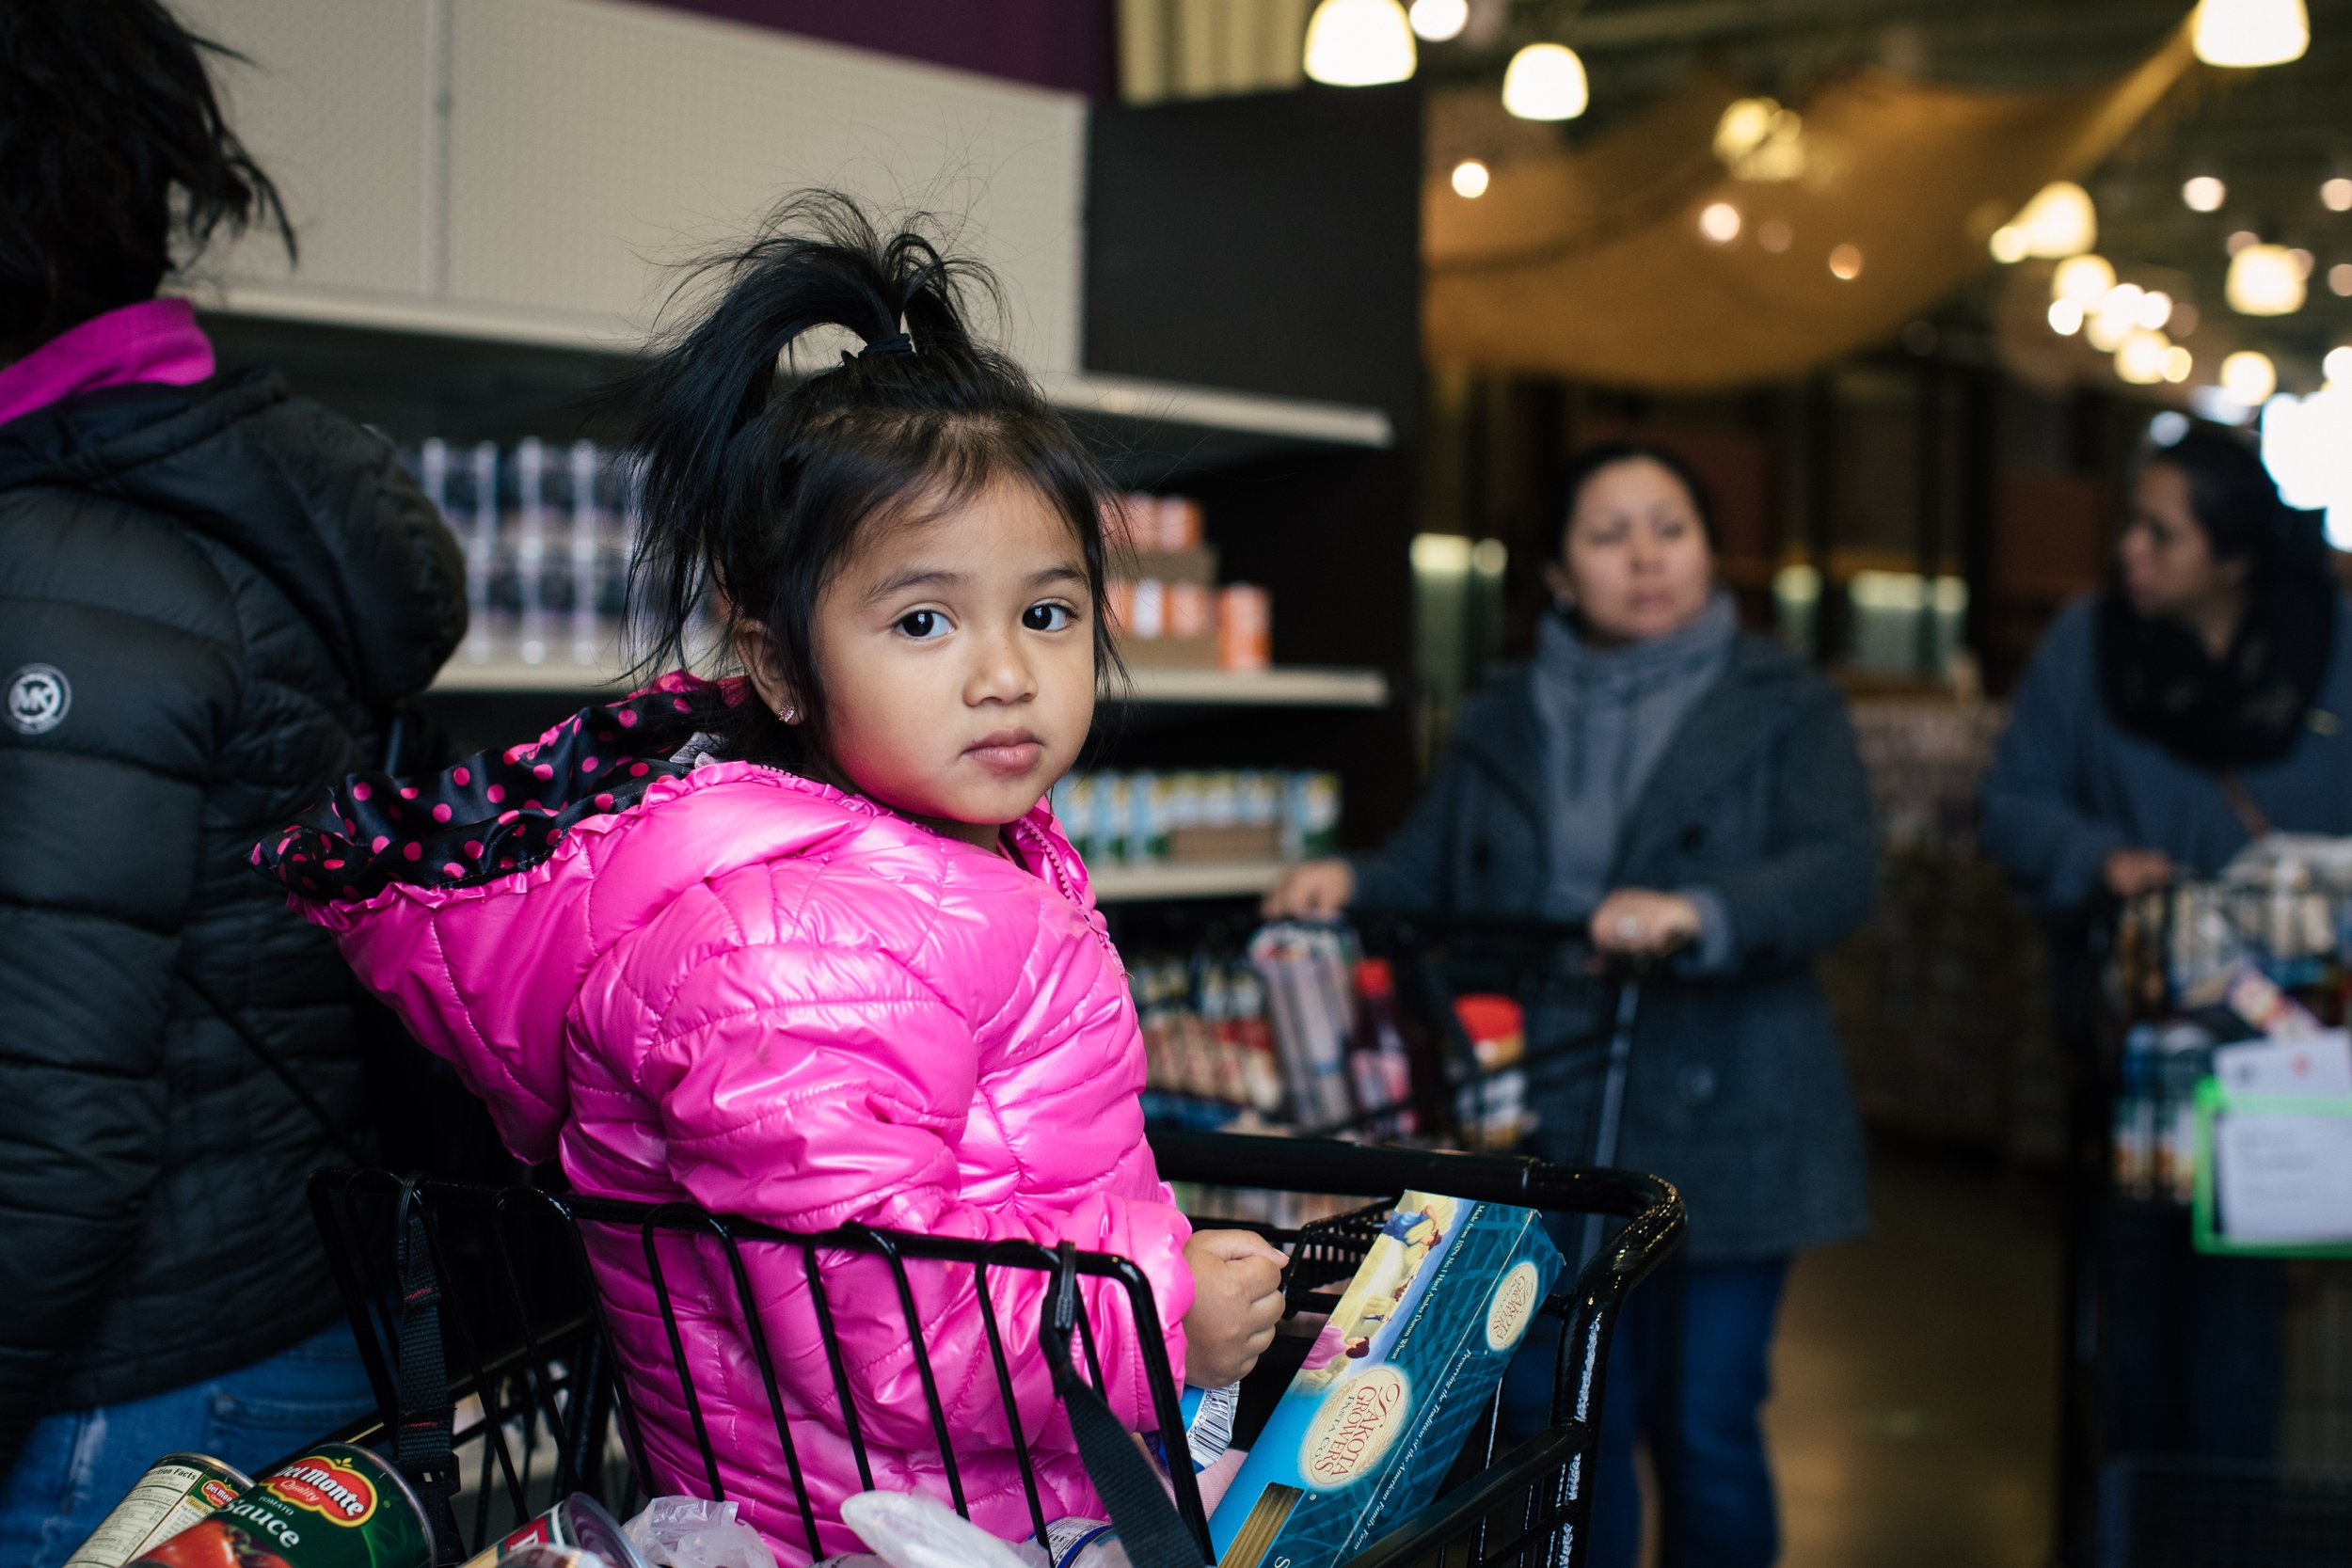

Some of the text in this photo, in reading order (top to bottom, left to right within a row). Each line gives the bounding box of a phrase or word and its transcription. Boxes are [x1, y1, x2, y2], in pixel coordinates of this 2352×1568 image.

[1470, 1205, 1485, 1223] Made
[1460, 1223, 1474, 1240] from
[1431, 1274, 1446, 1291] Hard
[1418, 1291, 1435, 1313] Amber
[1404, 1314, 1422, 1337] Durum
[1391, 1338, 1409, 1360] Wheat
[1328, 1396, 1355, 1433] PASTA
[1314, 1386, 1377, 1473] GROWERS
[1330, 1383, 1401, 1477] DAKOTA
[1354, 1349, 1472, 1550] Preserving the Tradition of the American Family Farm
[173, 1467, 197, 1481] Facts
[205, 1482, 232, 1503] Del Mon
[280, 1480, 320, 1503] Quality
[305, 1466, 365, 1517] Monte
